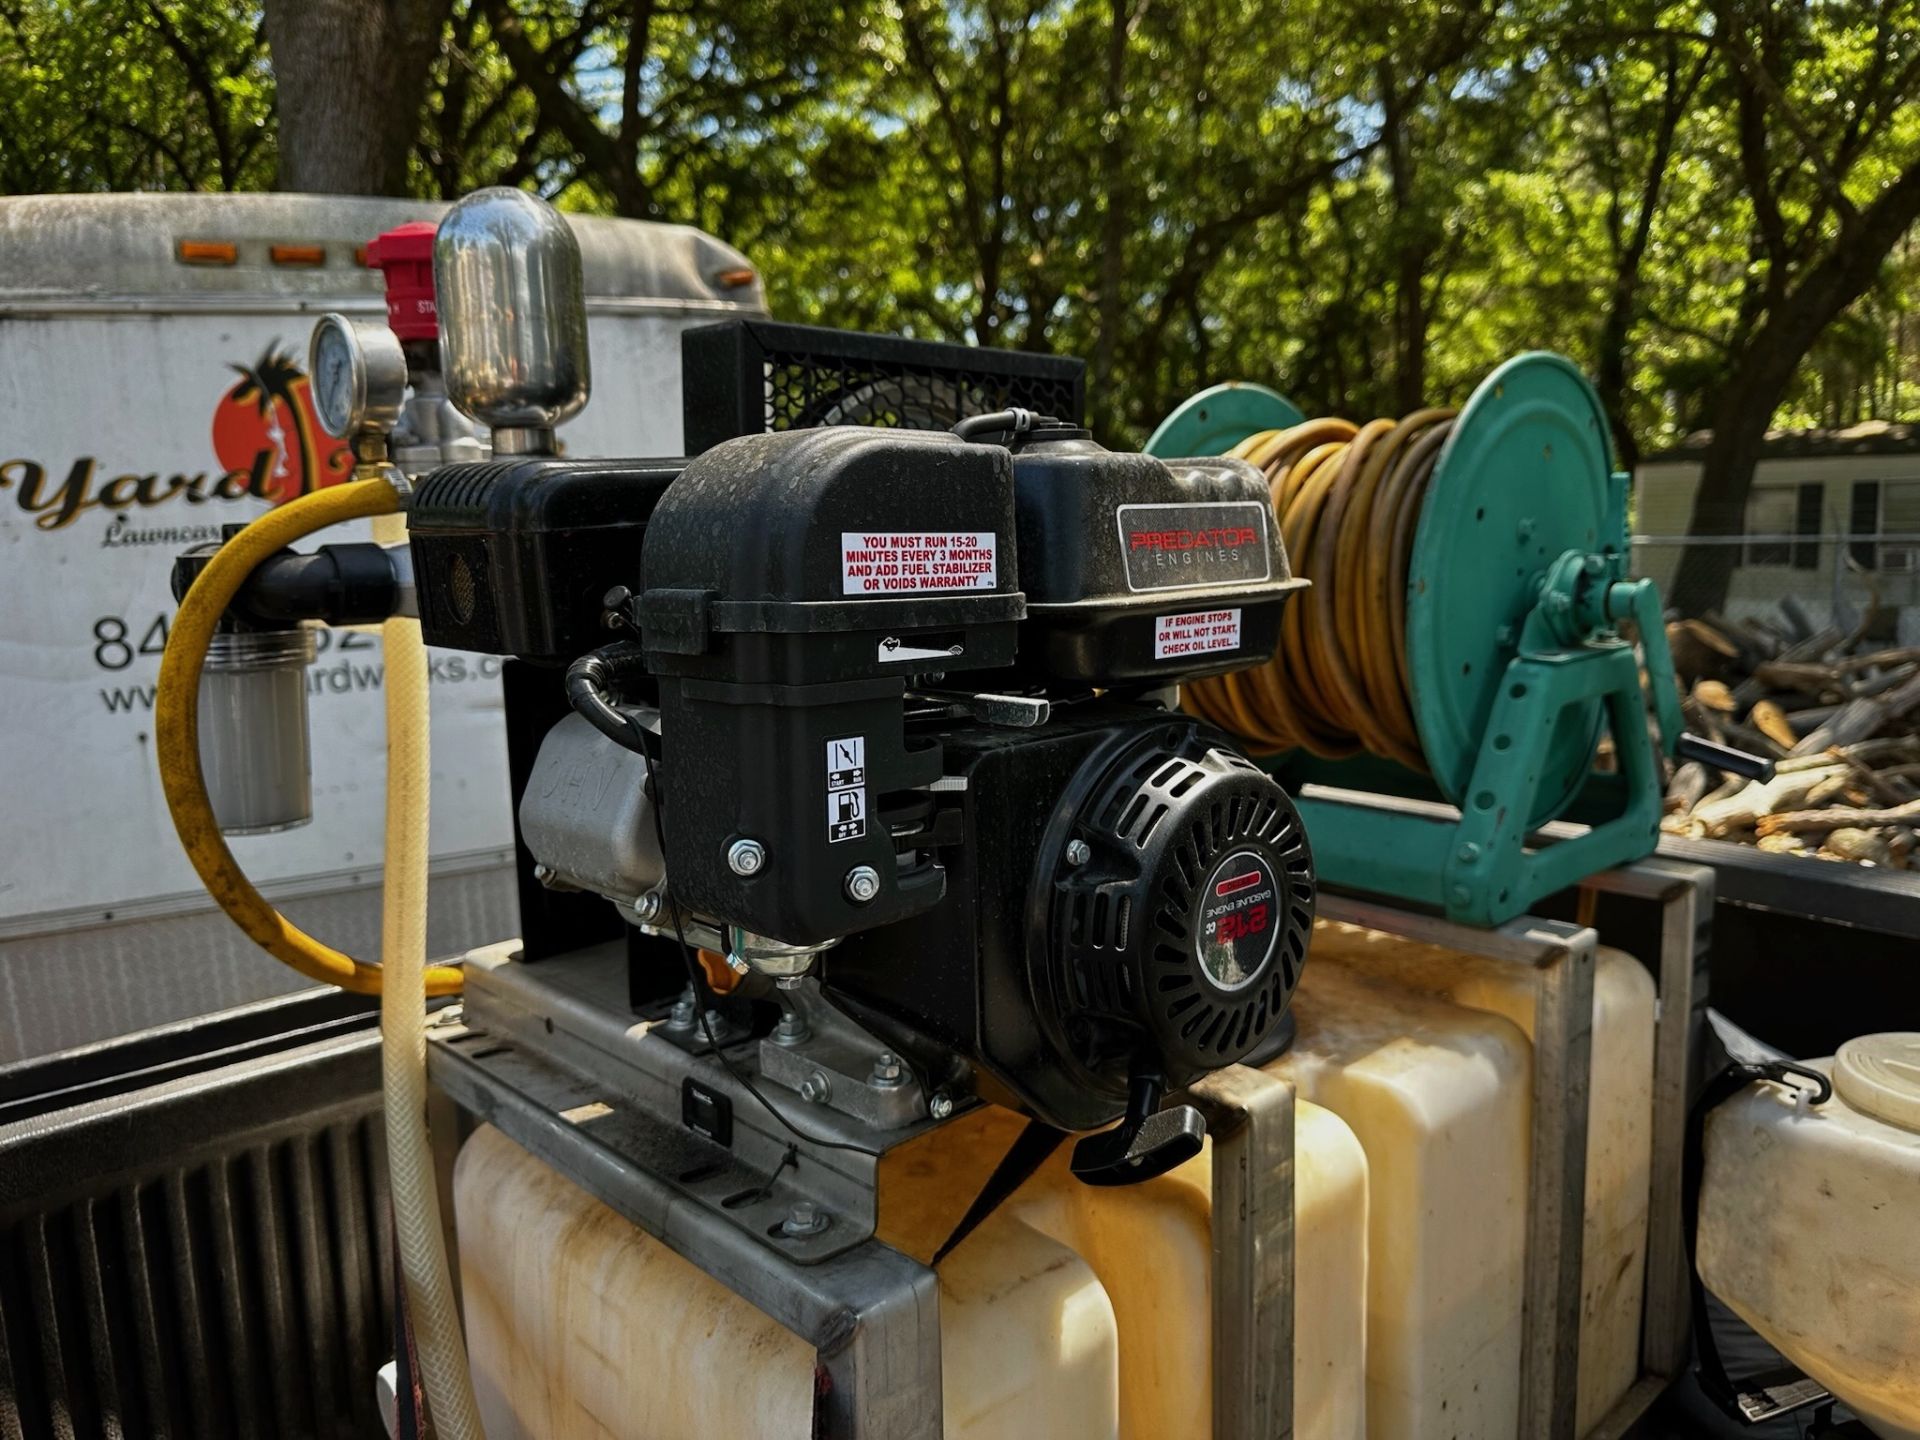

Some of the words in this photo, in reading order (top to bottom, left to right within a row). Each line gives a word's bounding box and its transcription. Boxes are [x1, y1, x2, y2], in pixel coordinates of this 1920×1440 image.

[863, 537, 887, 548] YOU
[890, 537, 921, 548] MUST
[925, 536, 947, 548] RUN
[951, 536, 977, 547] 15-20
[1130, 527, 1258, 551] PREDATOR
[846, 550, 898, 562] MINUTES
[901, 550, 936, 562] EVERY
[940, 550, 946, 560] 3
[949, 549, 992, 561] MONTHS
[1156, 549, 1239, 566] ENGINES
[848, 565, 872, 577] AND
[876, 564, 898, 576] ADD
[902, 564, 929, 575] FUEL
[932, 562, 992, 575] STABILIZER
[863, 578, 880, 590] OR
[883, 577, 916, 589] VOIDS
[920, 575, 979, 588] WARRANTY
[1165, 618, 1174, 627] IF
[1175, 614, 1206, 626] ENGINE
[1207, 612, 1232, 623] STOPS
[1159, 632, 1170, 641] OR
[1172, 629, 1192, 640] WILL
[1194, 628, 1210, 637] NOT
[1162, 643, 1190, 655] CHECK
[1192, 641, 1205, 651] OIL
[1236, 889, 1271, 908] GASOLINE
[1206, 902, 1235, 918] ENGINE
[1216, 904, 1268, 945] 212
